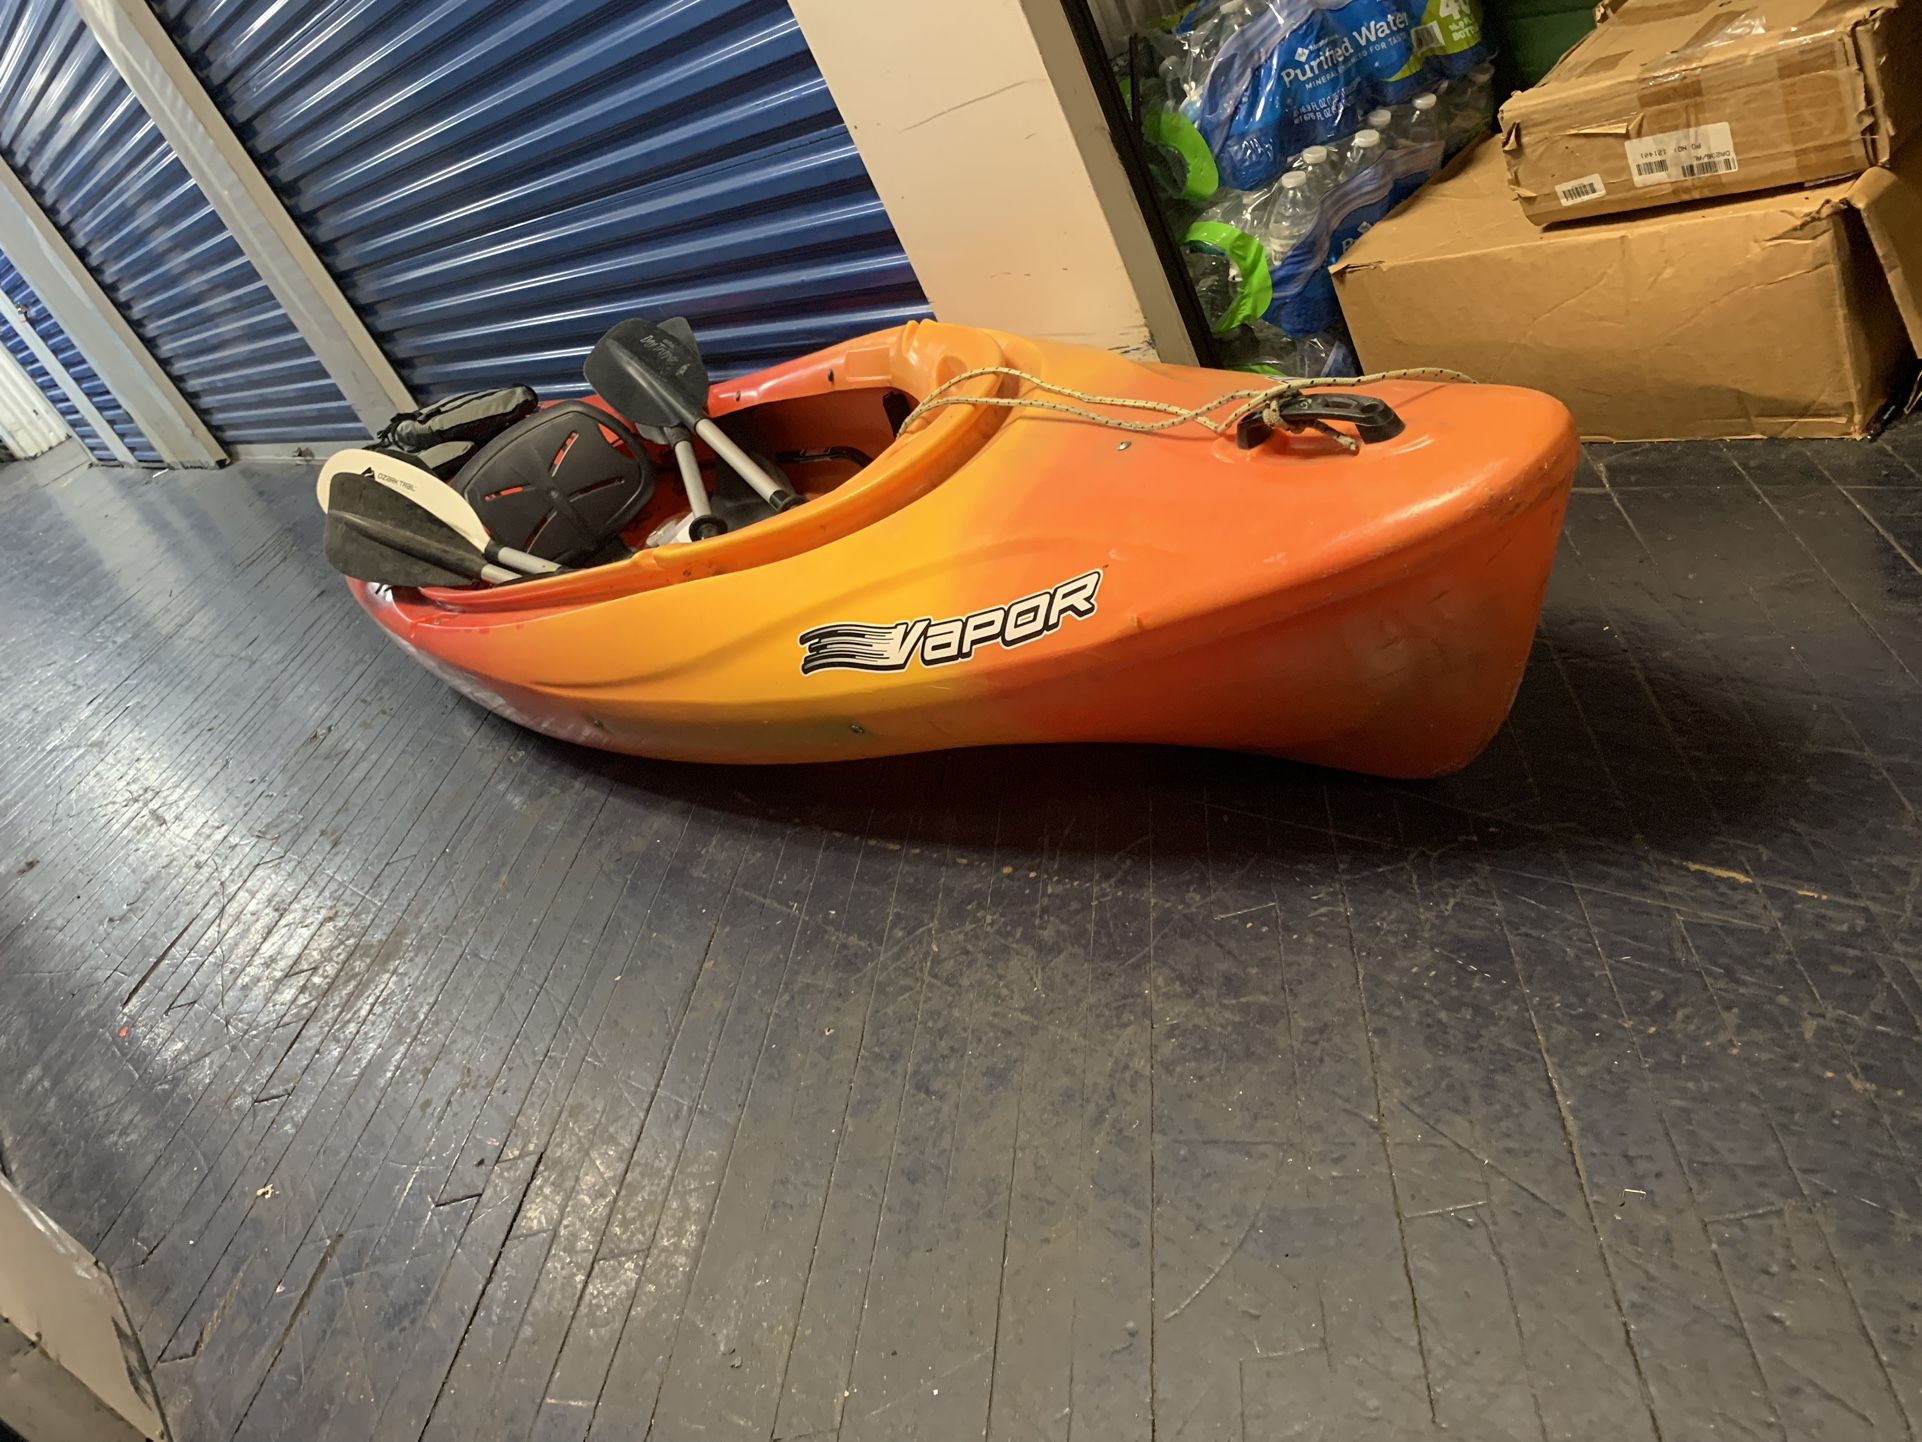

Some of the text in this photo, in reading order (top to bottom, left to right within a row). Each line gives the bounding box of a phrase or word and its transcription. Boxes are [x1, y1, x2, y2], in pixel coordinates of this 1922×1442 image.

[1281, 12, 1409, 88] Purified Water
[1369, 42, 1388, 53] FOR
[886, 570, 1102, 673] VAPOR
